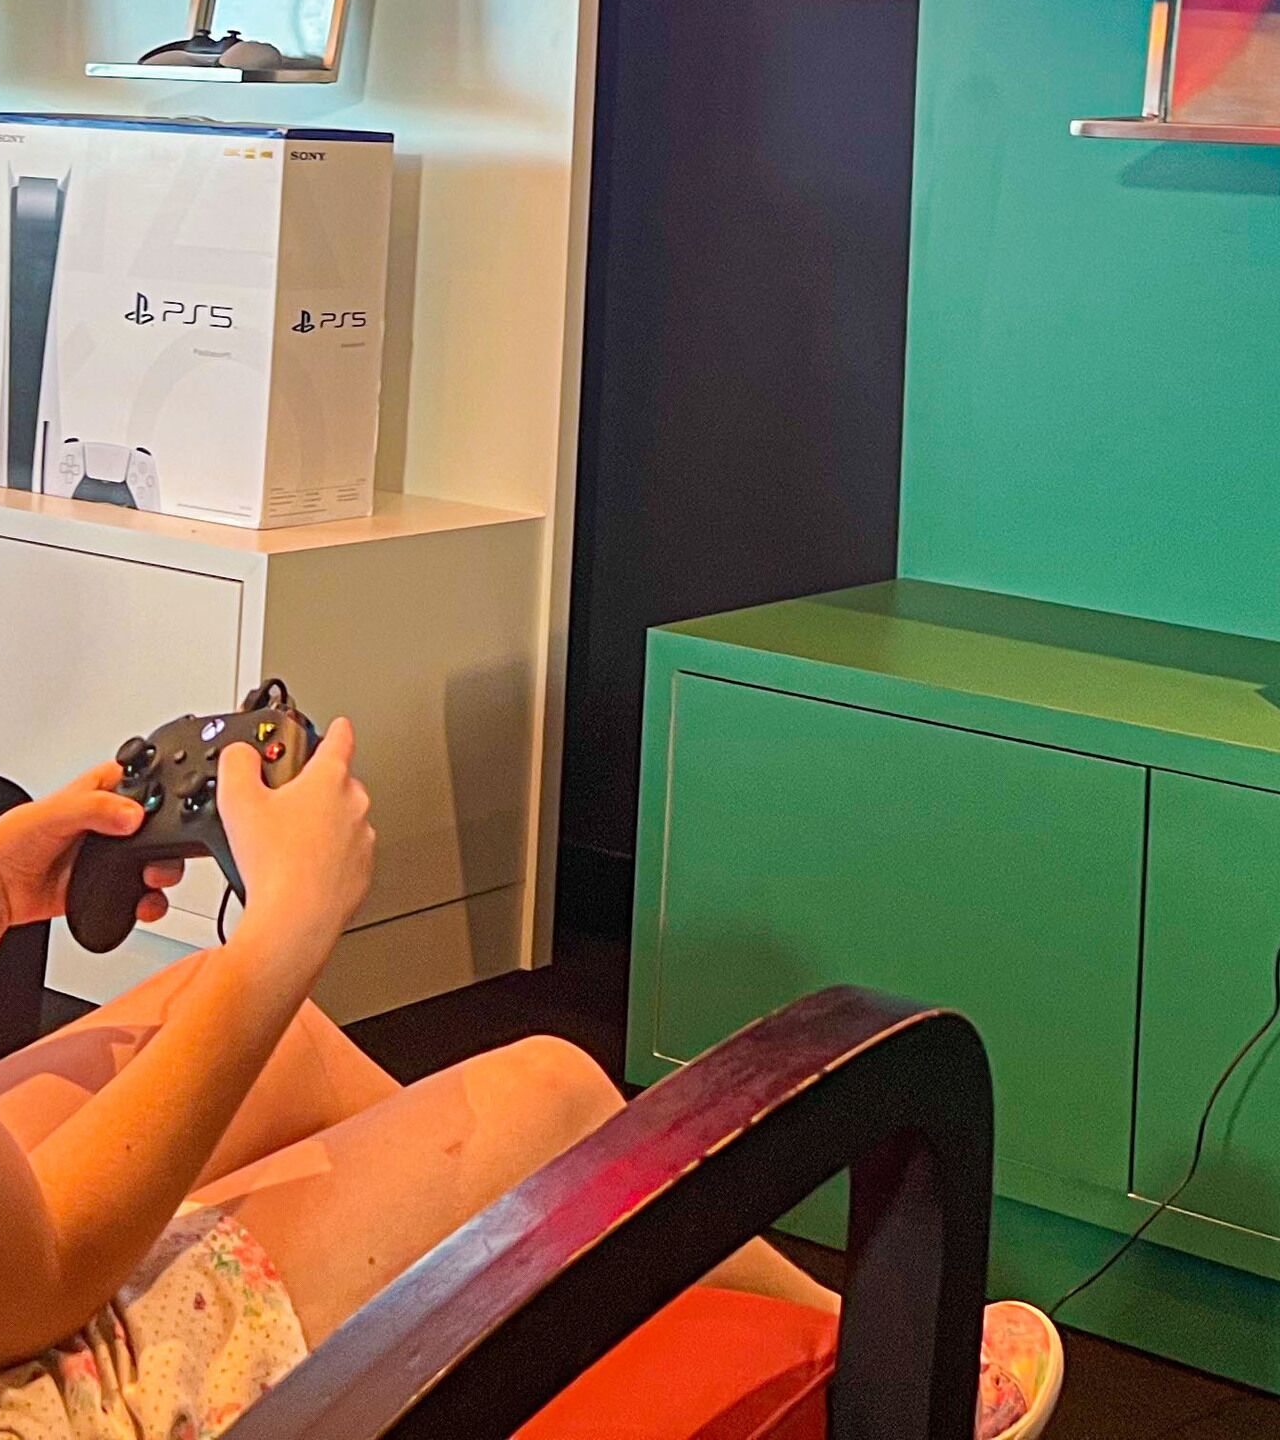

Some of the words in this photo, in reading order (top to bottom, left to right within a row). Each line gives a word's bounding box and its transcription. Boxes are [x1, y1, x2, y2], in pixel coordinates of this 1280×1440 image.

[290, 151, 326, 161] SONY
[162, 300, 234, 329] PS5
[320, 311, 367, 328] PS5
